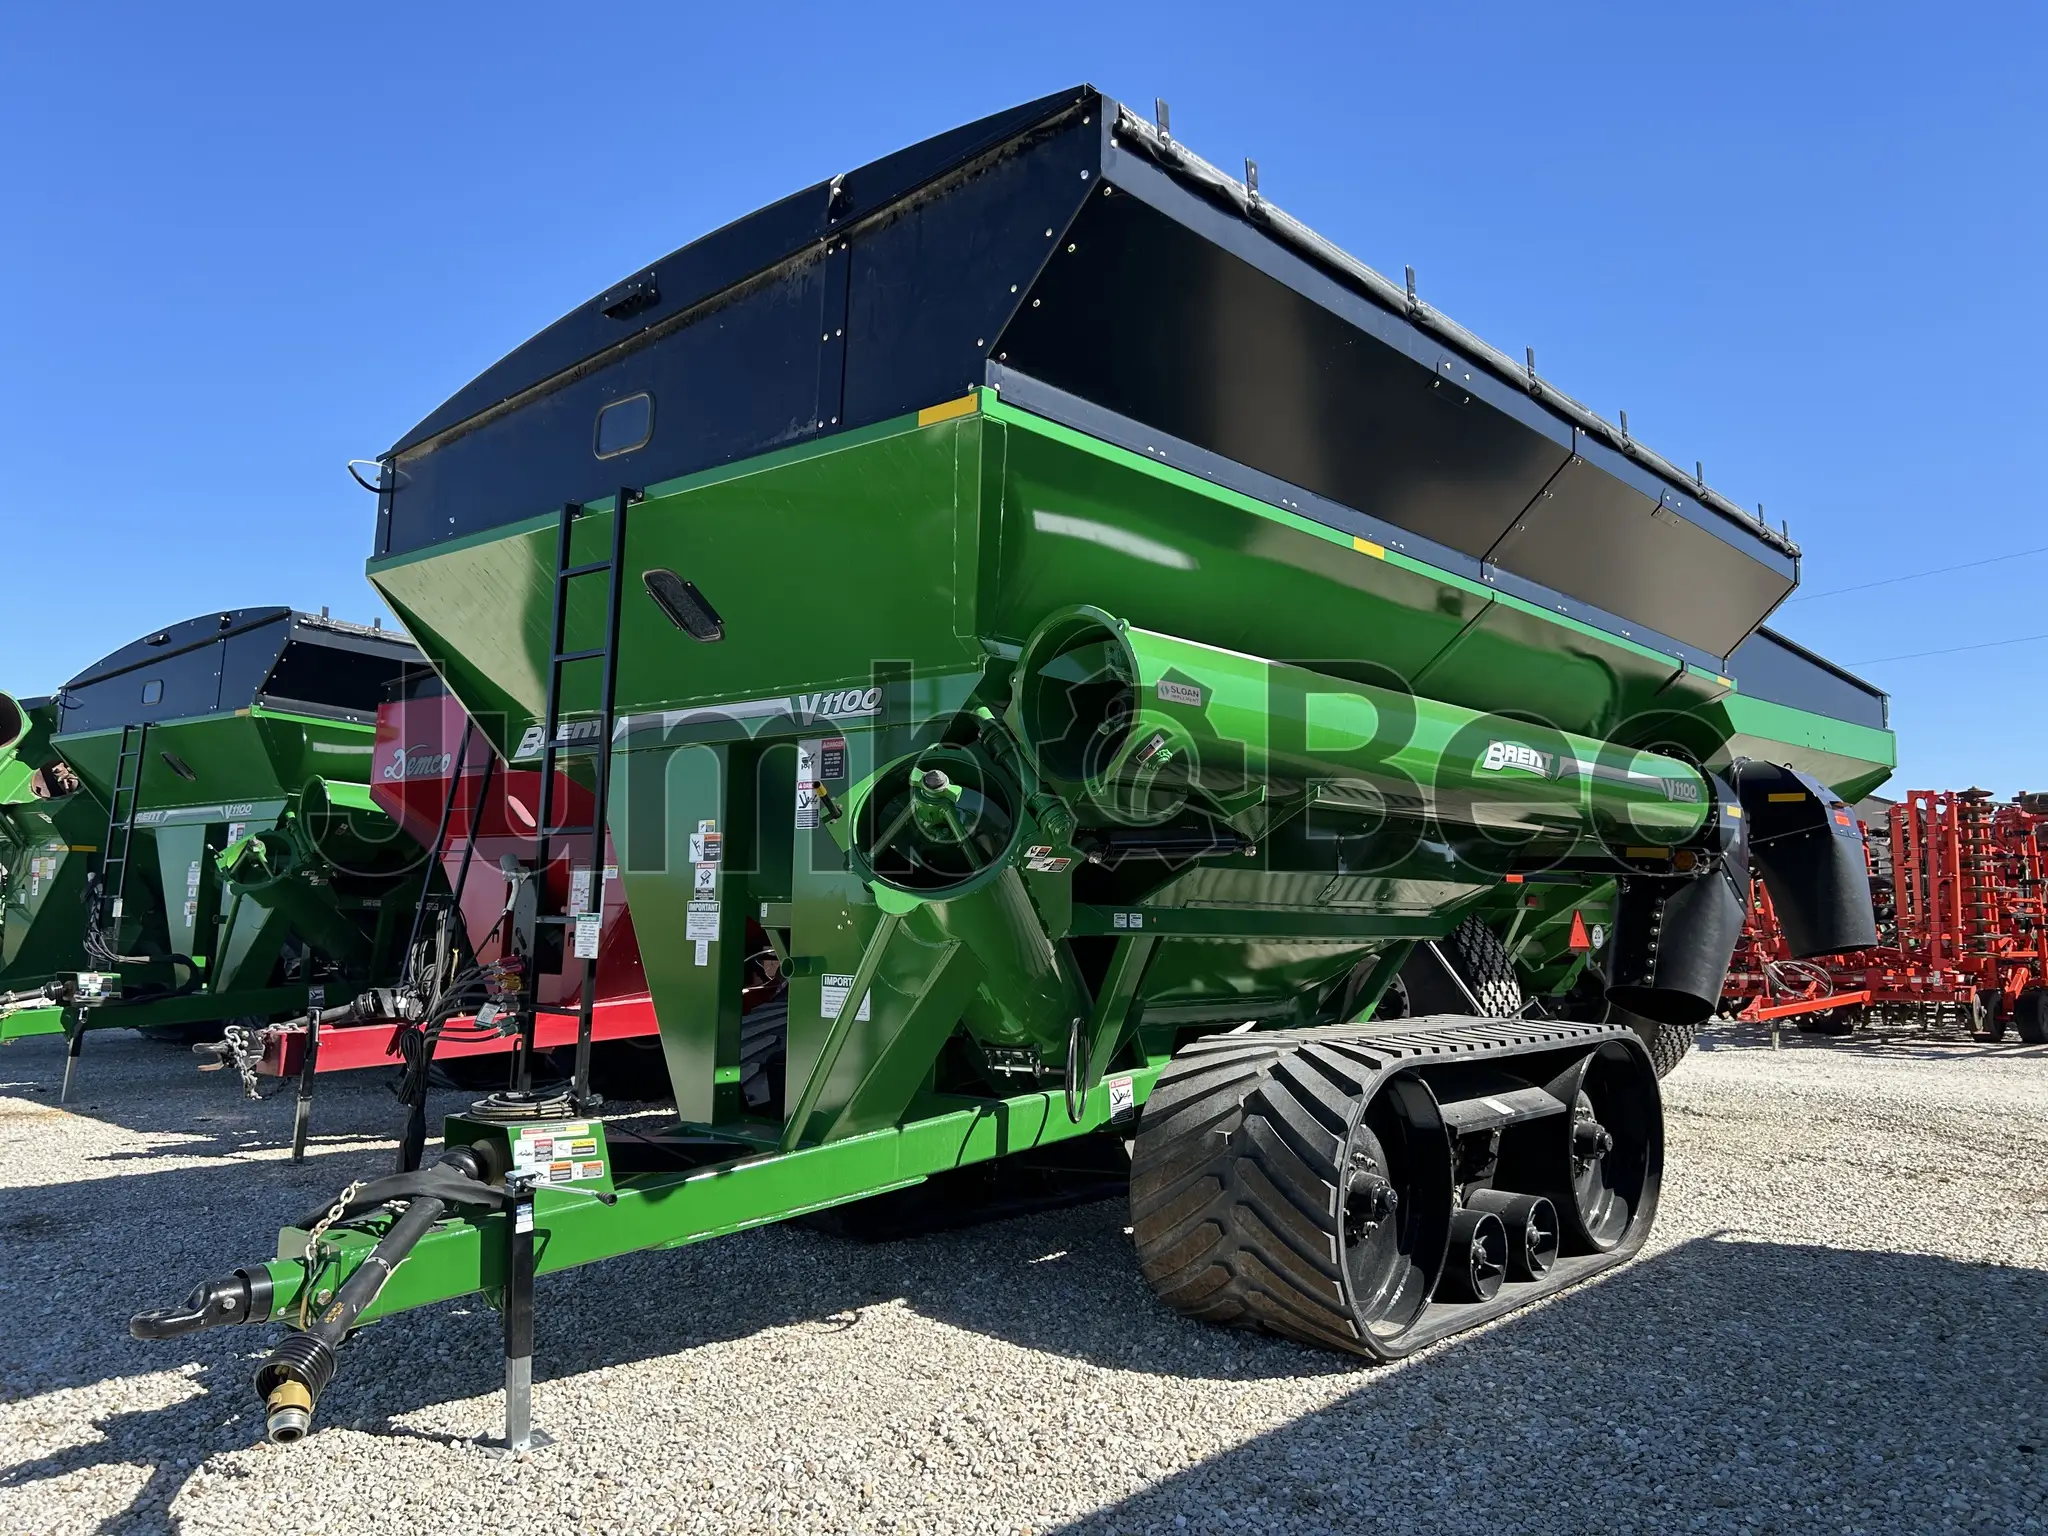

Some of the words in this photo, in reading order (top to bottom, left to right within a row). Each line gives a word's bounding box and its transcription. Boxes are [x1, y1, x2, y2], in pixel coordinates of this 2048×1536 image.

[1170, 685, 1199, 698] SLOAN
[798, 687, 882, 726] V1100
[384, 744, 451, 780] Demco
[1481, 741, 1554, 774] BRENT
[1665, 777, 1698, 803] V1100
[225, 804, 252, 819] V1100
[688, 903, 719, 912] IMPORTANT
[824, 976, 853, 987] IMPORT
